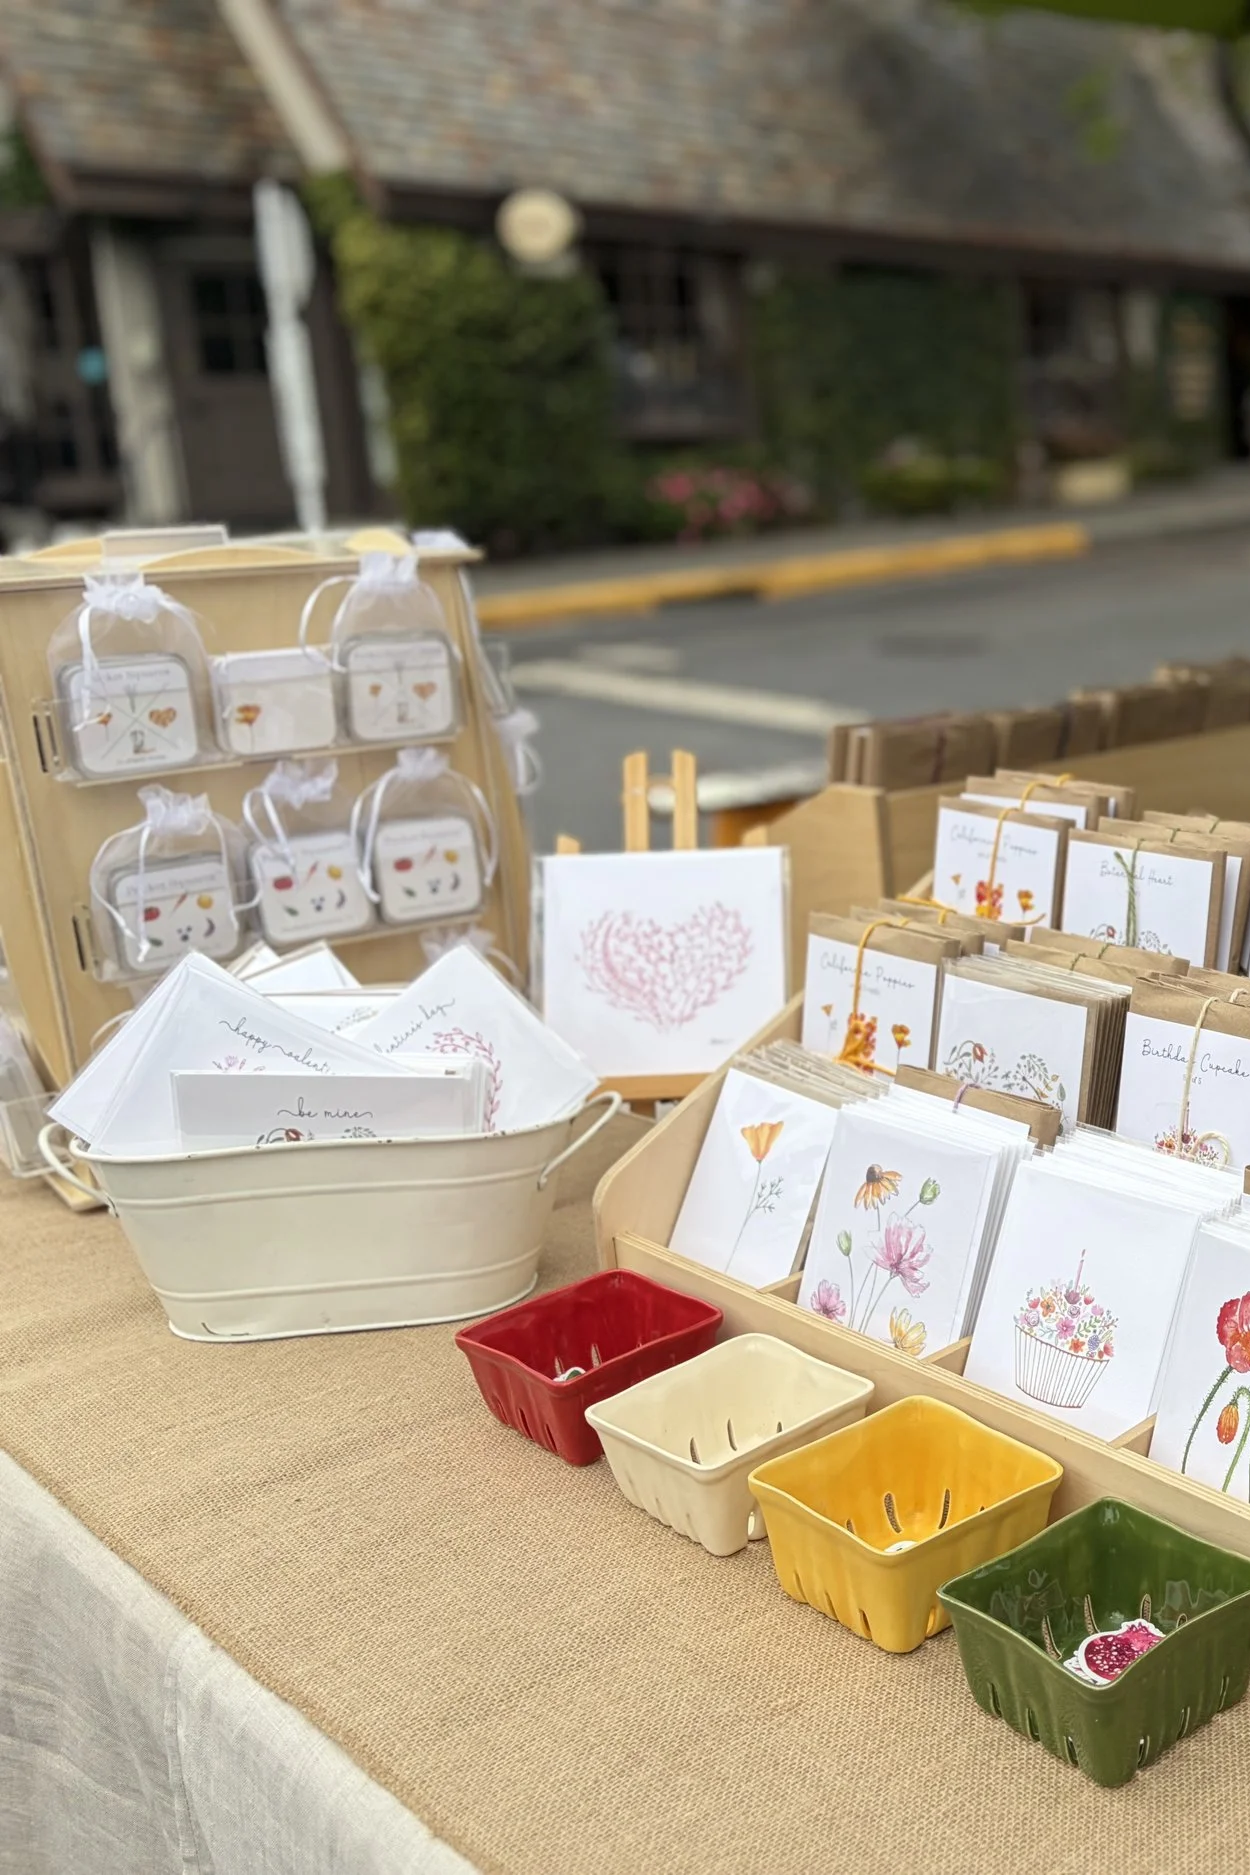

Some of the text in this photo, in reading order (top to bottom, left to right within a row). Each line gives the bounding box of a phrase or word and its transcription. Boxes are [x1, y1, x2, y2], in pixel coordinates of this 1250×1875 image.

[1100, 860, 1145, 881] Botanal
[219, 1016, 272, 1053] happy
[1200, 1053, 1250, 1078] Cupcake
[277, 1096, 373, 1119] be mine
